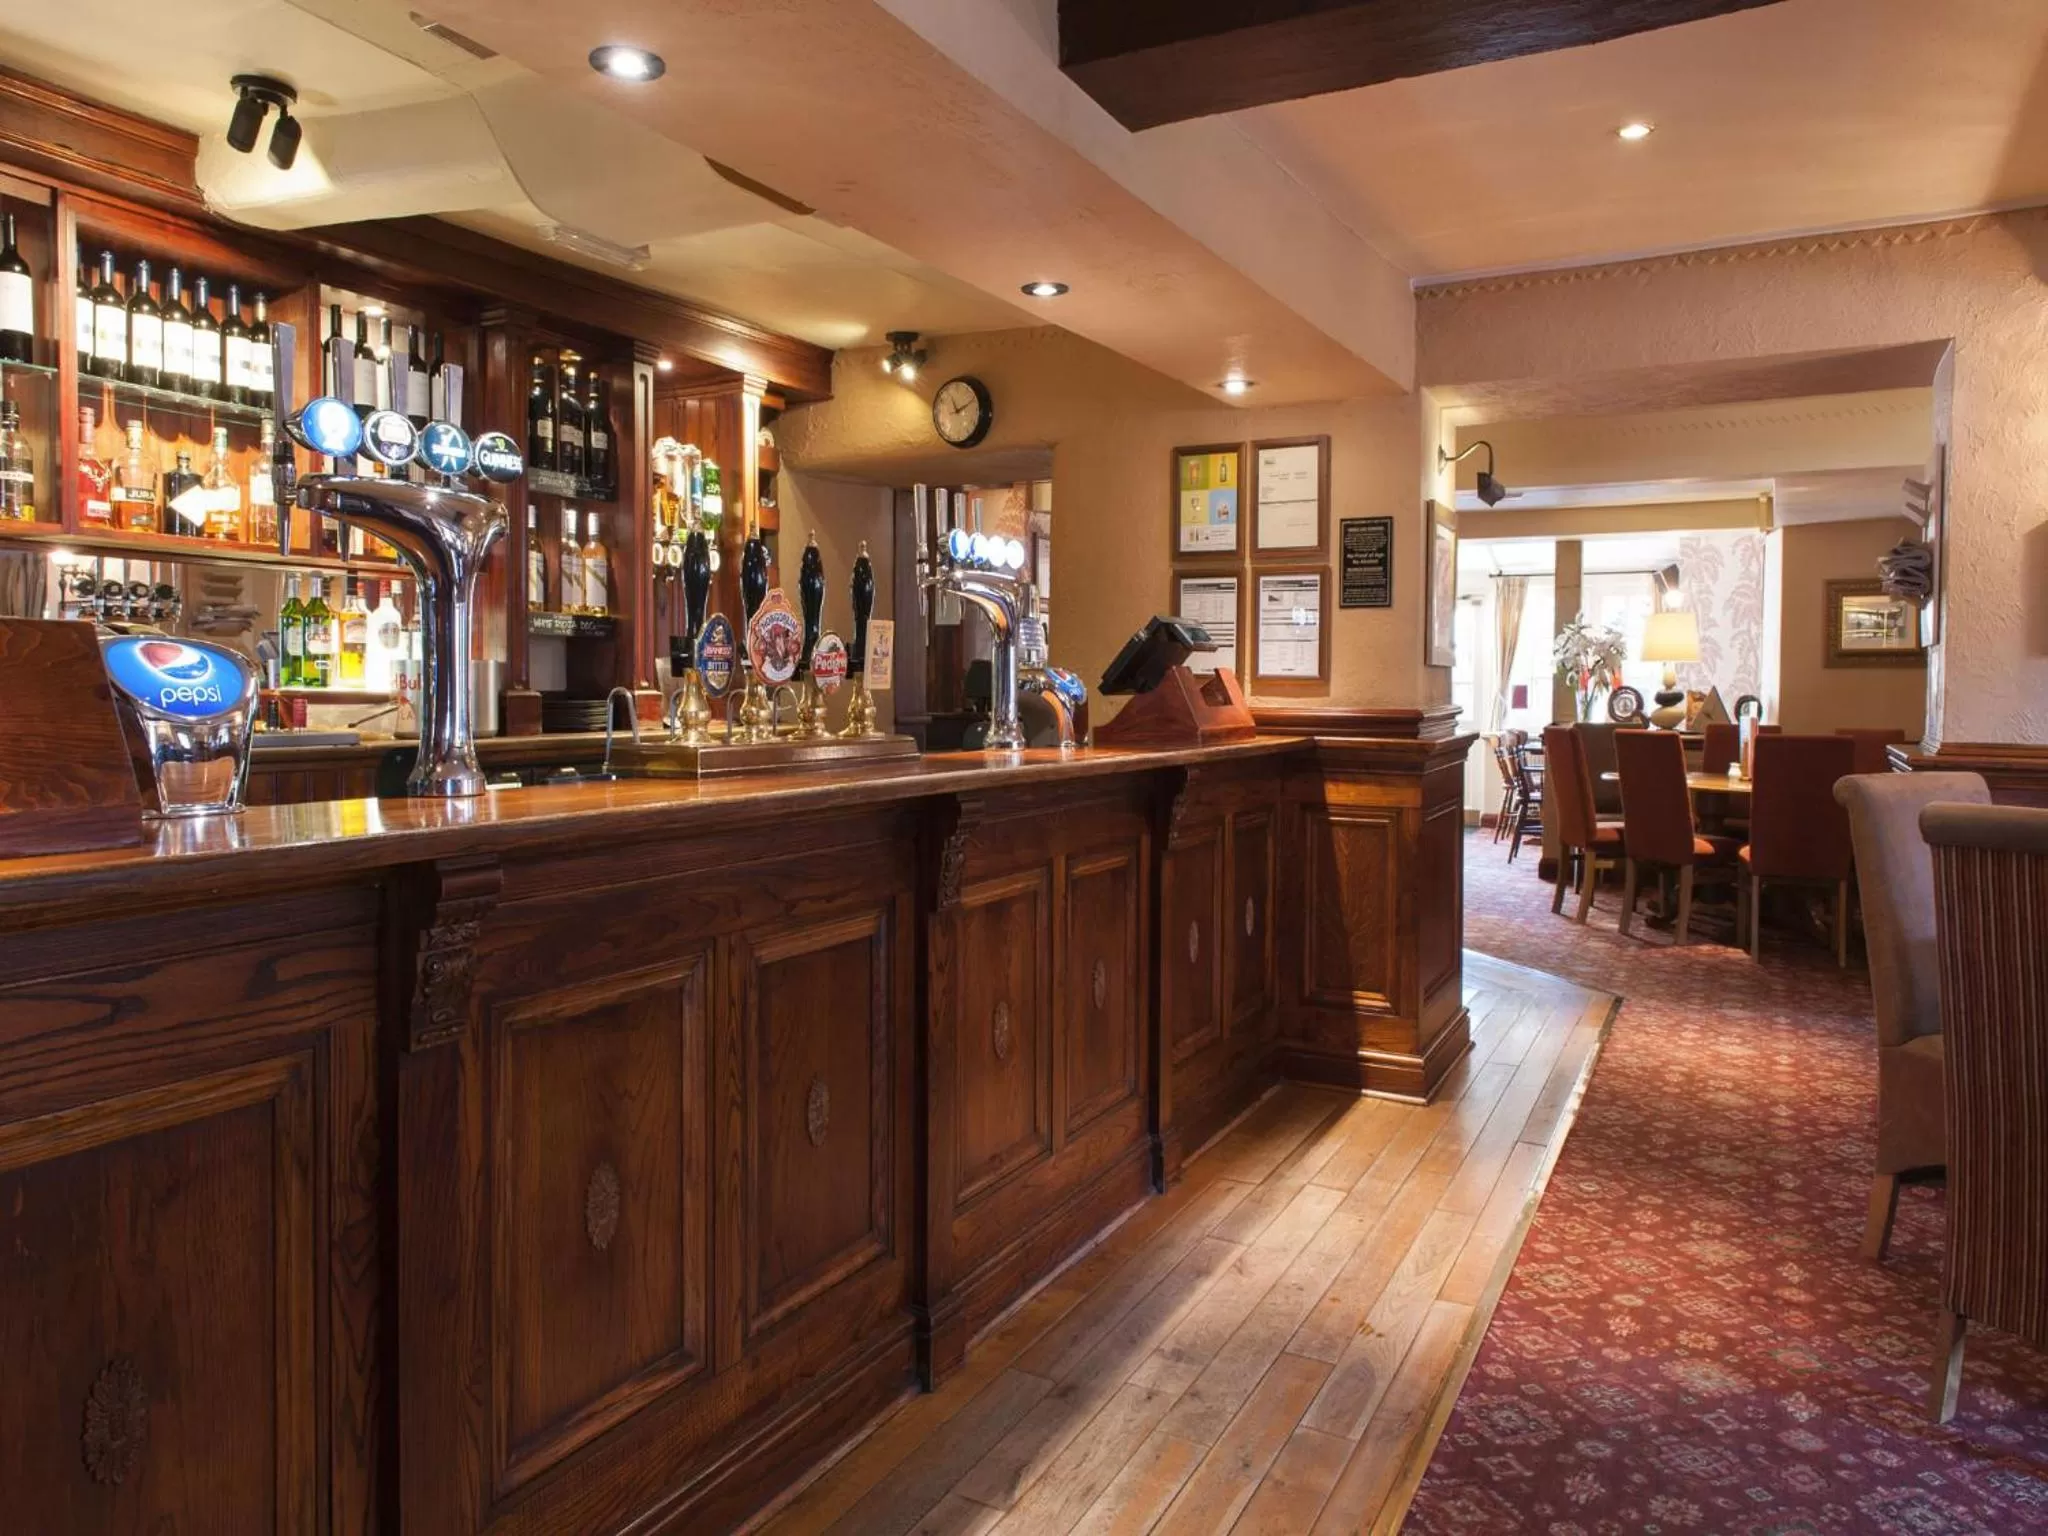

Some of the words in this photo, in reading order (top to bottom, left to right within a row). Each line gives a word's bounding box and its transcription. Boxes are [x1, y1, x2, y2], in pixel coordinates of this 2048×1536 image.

[480, 451, 523, 474] GUINNESS
[128, 489, 156, 501] JURA
[160, 684, 222, 708] pepsi
